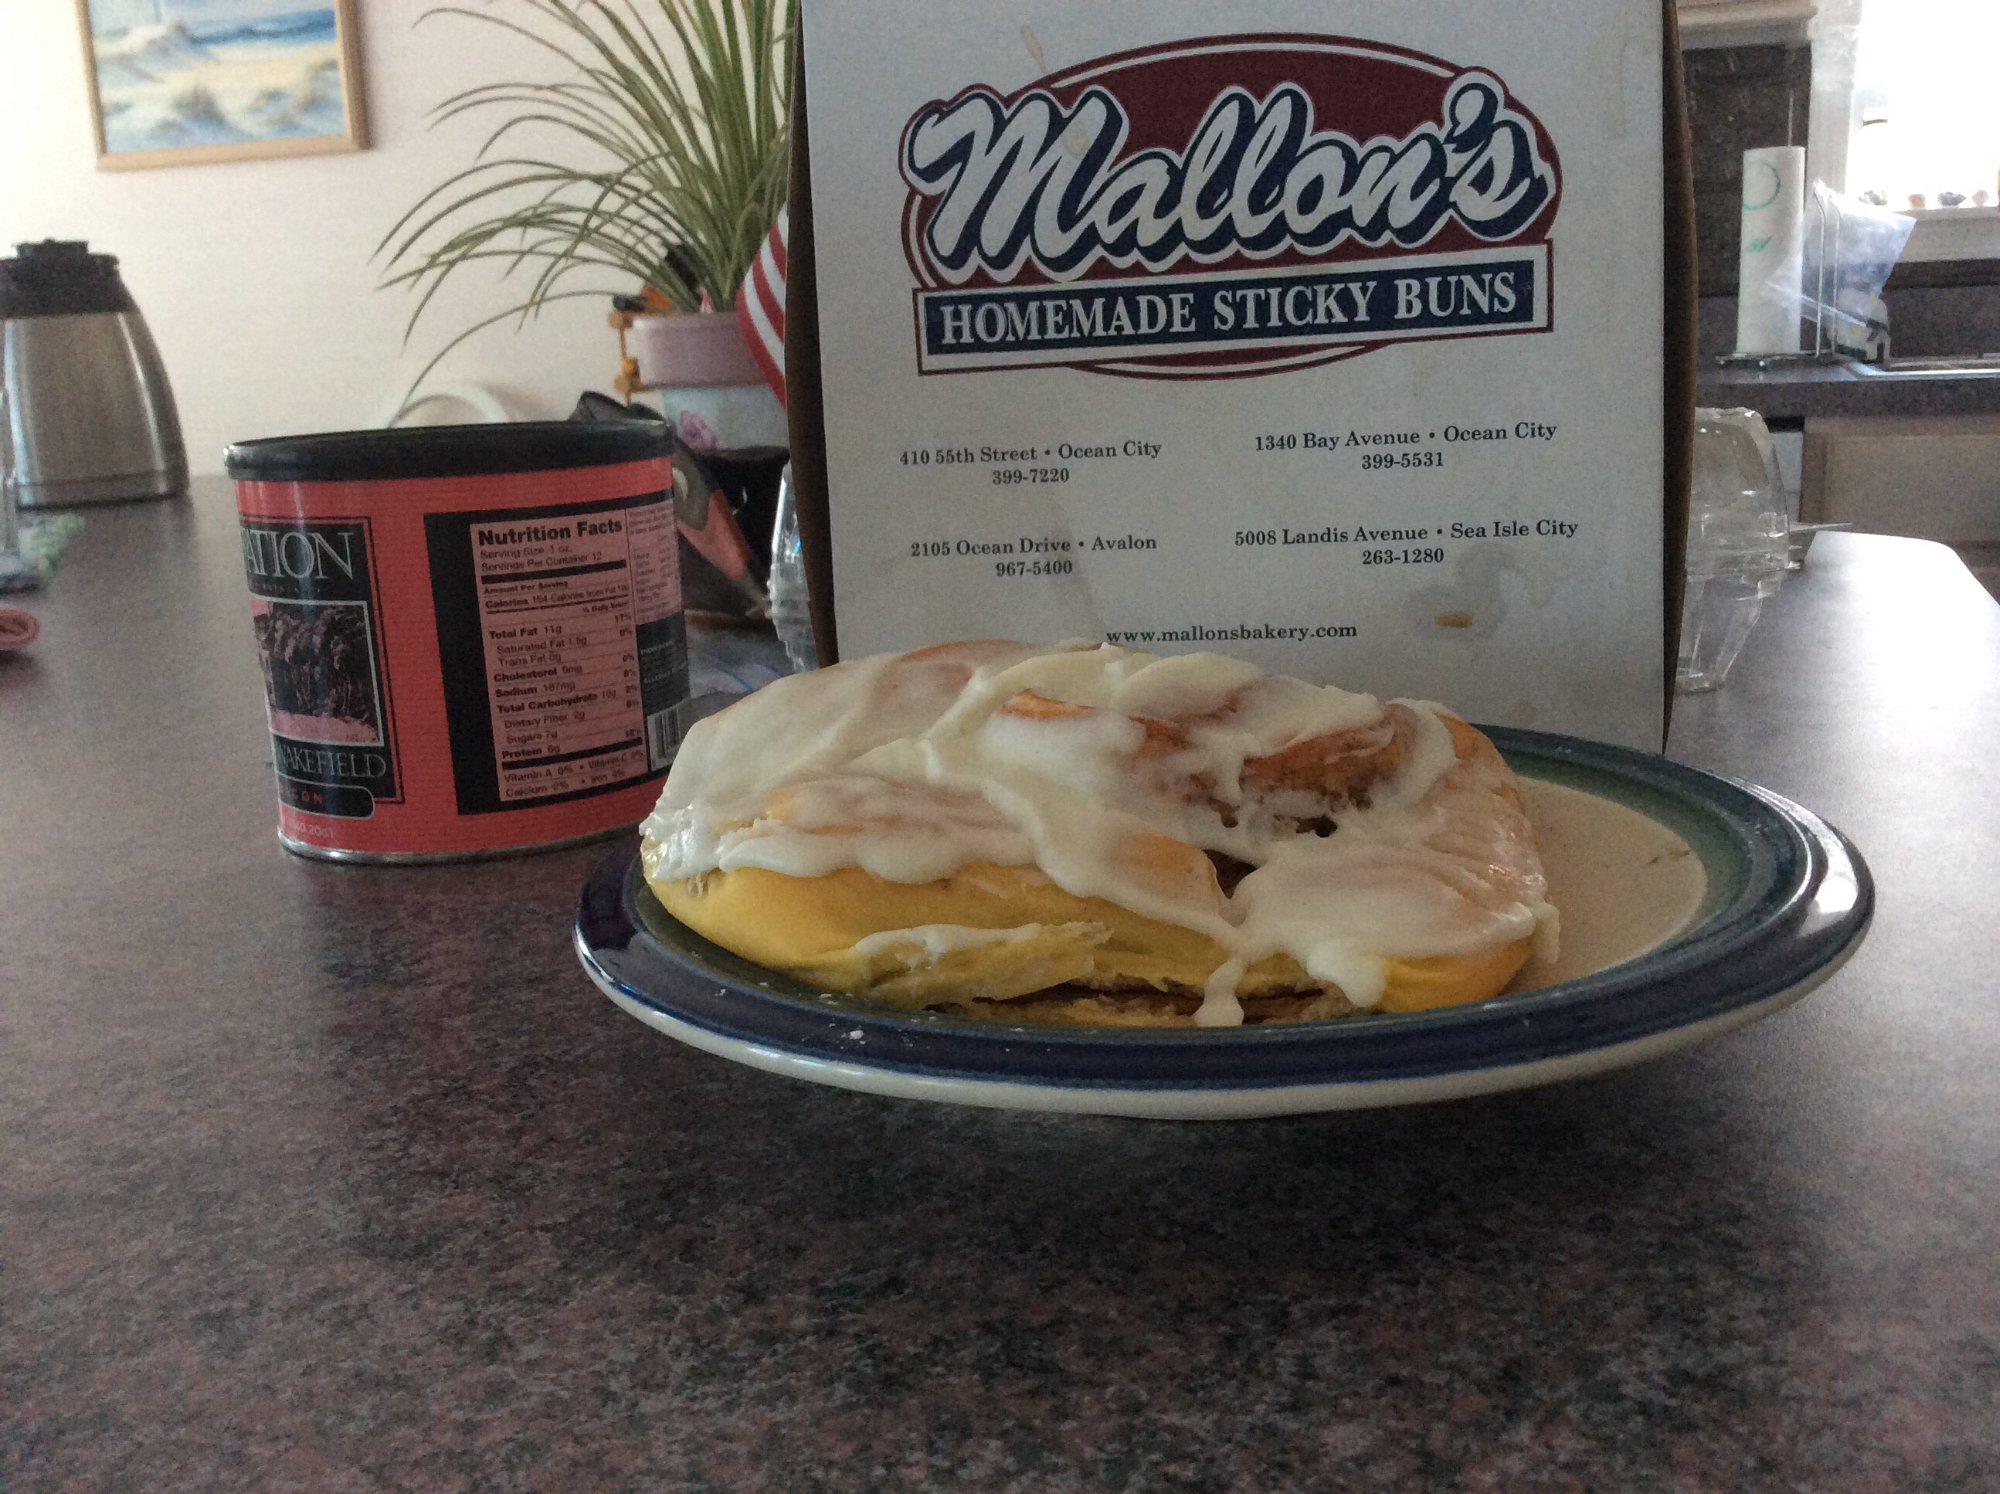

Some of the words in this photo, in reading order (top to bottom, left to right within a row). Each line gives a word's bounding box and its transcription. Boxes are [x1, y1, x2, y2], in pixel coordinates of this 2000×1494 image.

[908, 80, 1550, 273] Mallon's
[940, 292, 1197, 346] HOMEMADE
[1212, 280, 1379, 331] STICKY
[1393, 271, 1517, 320] BUNS
[1255, 433, 1297, 451] 1340
[1302, 432, 1340, 450] Bay
[1344, 430, 1420, 446] Avenue
[1443, 425, 1508, 442] Ocean
[1514, 422, 1558, 440] City
[899, 449, 931, 465] 410
[935, 447, 975, 464] 55th
[980, 446, 1039, 462] Street
[1057, 443, 1118, 459] Ocean
[1122, 440, 1162, 459] City
[1361, 452, 1444, 470] 399-5531
[992, 467, 1070, 485] 399-7220
[478, 525, 571, 546] Nutrition
[576, 518, 622, 537] Facts
[1234, 530, 1277, 546] 5008
[1282, 527, 1349, 545] Landis
[1353, 526, 1428, 542] Avenue
[1450, 521, 1487, 539] Sea
[1492, 520, 1530, 538] Isle
[1535, 519, 1579, 538] City
[910, 541, 951, 557] 2105
[956, 540, 1014, 555] Ocean
[1019, 537, 1071, 554] Drive
[1091, 534, 1158, 551] Avalon
[545, 553, 588, 567] Container
[1362, 548, 1445, 566] 263-1280
[995, 560, 1073, 577] 967-5400
[520, 583, 535, 591] Per
[485, 598, 529, 609] Calories
[488, 628, 517, 640] Total
[520, 626, 538, 637] Fat
[1106, 624, 1358, 642] www.mallonsbakery.com
[494, 666, 557, 682] Cholesterol
[494, 685, 538, 698] Sodium
[497, 702, 525, 714] Total
[528, 692, 598, 711] Carbohydrate
[504, 716, 541, 730] Dietary
[506, 732, 543, 745] Sugars
[501, 747, 543, 760] Protein
[504, 770, 542, 783] Vitamin
